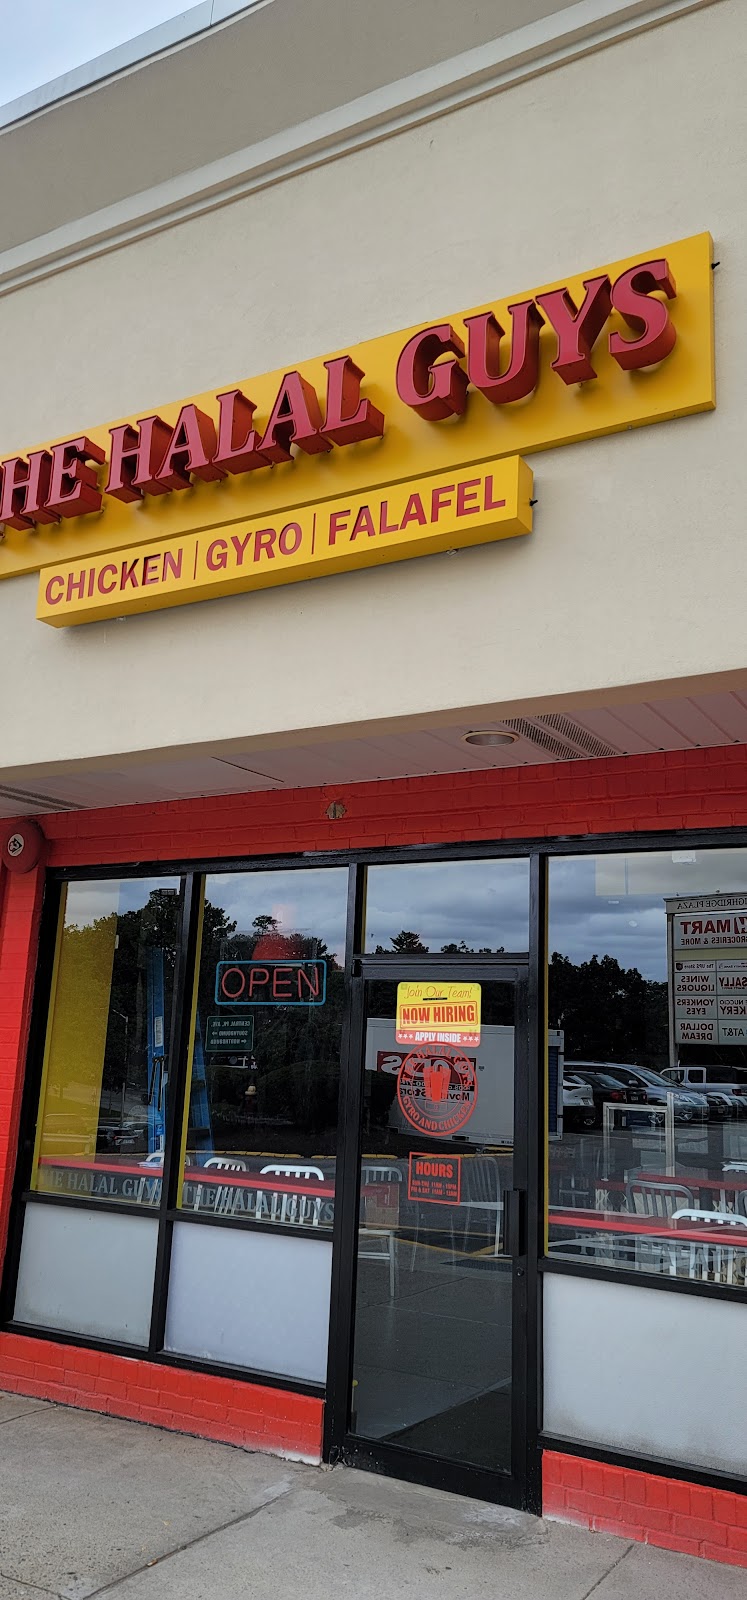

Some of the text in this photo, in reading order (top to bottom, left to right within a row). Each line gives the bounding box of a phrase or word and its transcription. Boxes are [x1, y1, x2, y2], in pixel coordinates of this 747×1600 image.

[0, 258, 676, 530] HE HALAL GUYS
[45, 475, 506, 605] CHICKEN GYRO FALAFEL
[221, 968, 319, 998] OPEN
[404, 985, 472, 999] Join Our Team!
[402, 1005, 475, 1024] NOW HIRING
[415, 1032, 461, 1042] APPLY INSIDE
[403, 1096, 420, 1119] GYRO
[419, 1117, 437, 1130] AND
[415, 1161, 454, 1178] HOURS
[67, 1172, 118, 1195] HALAL
